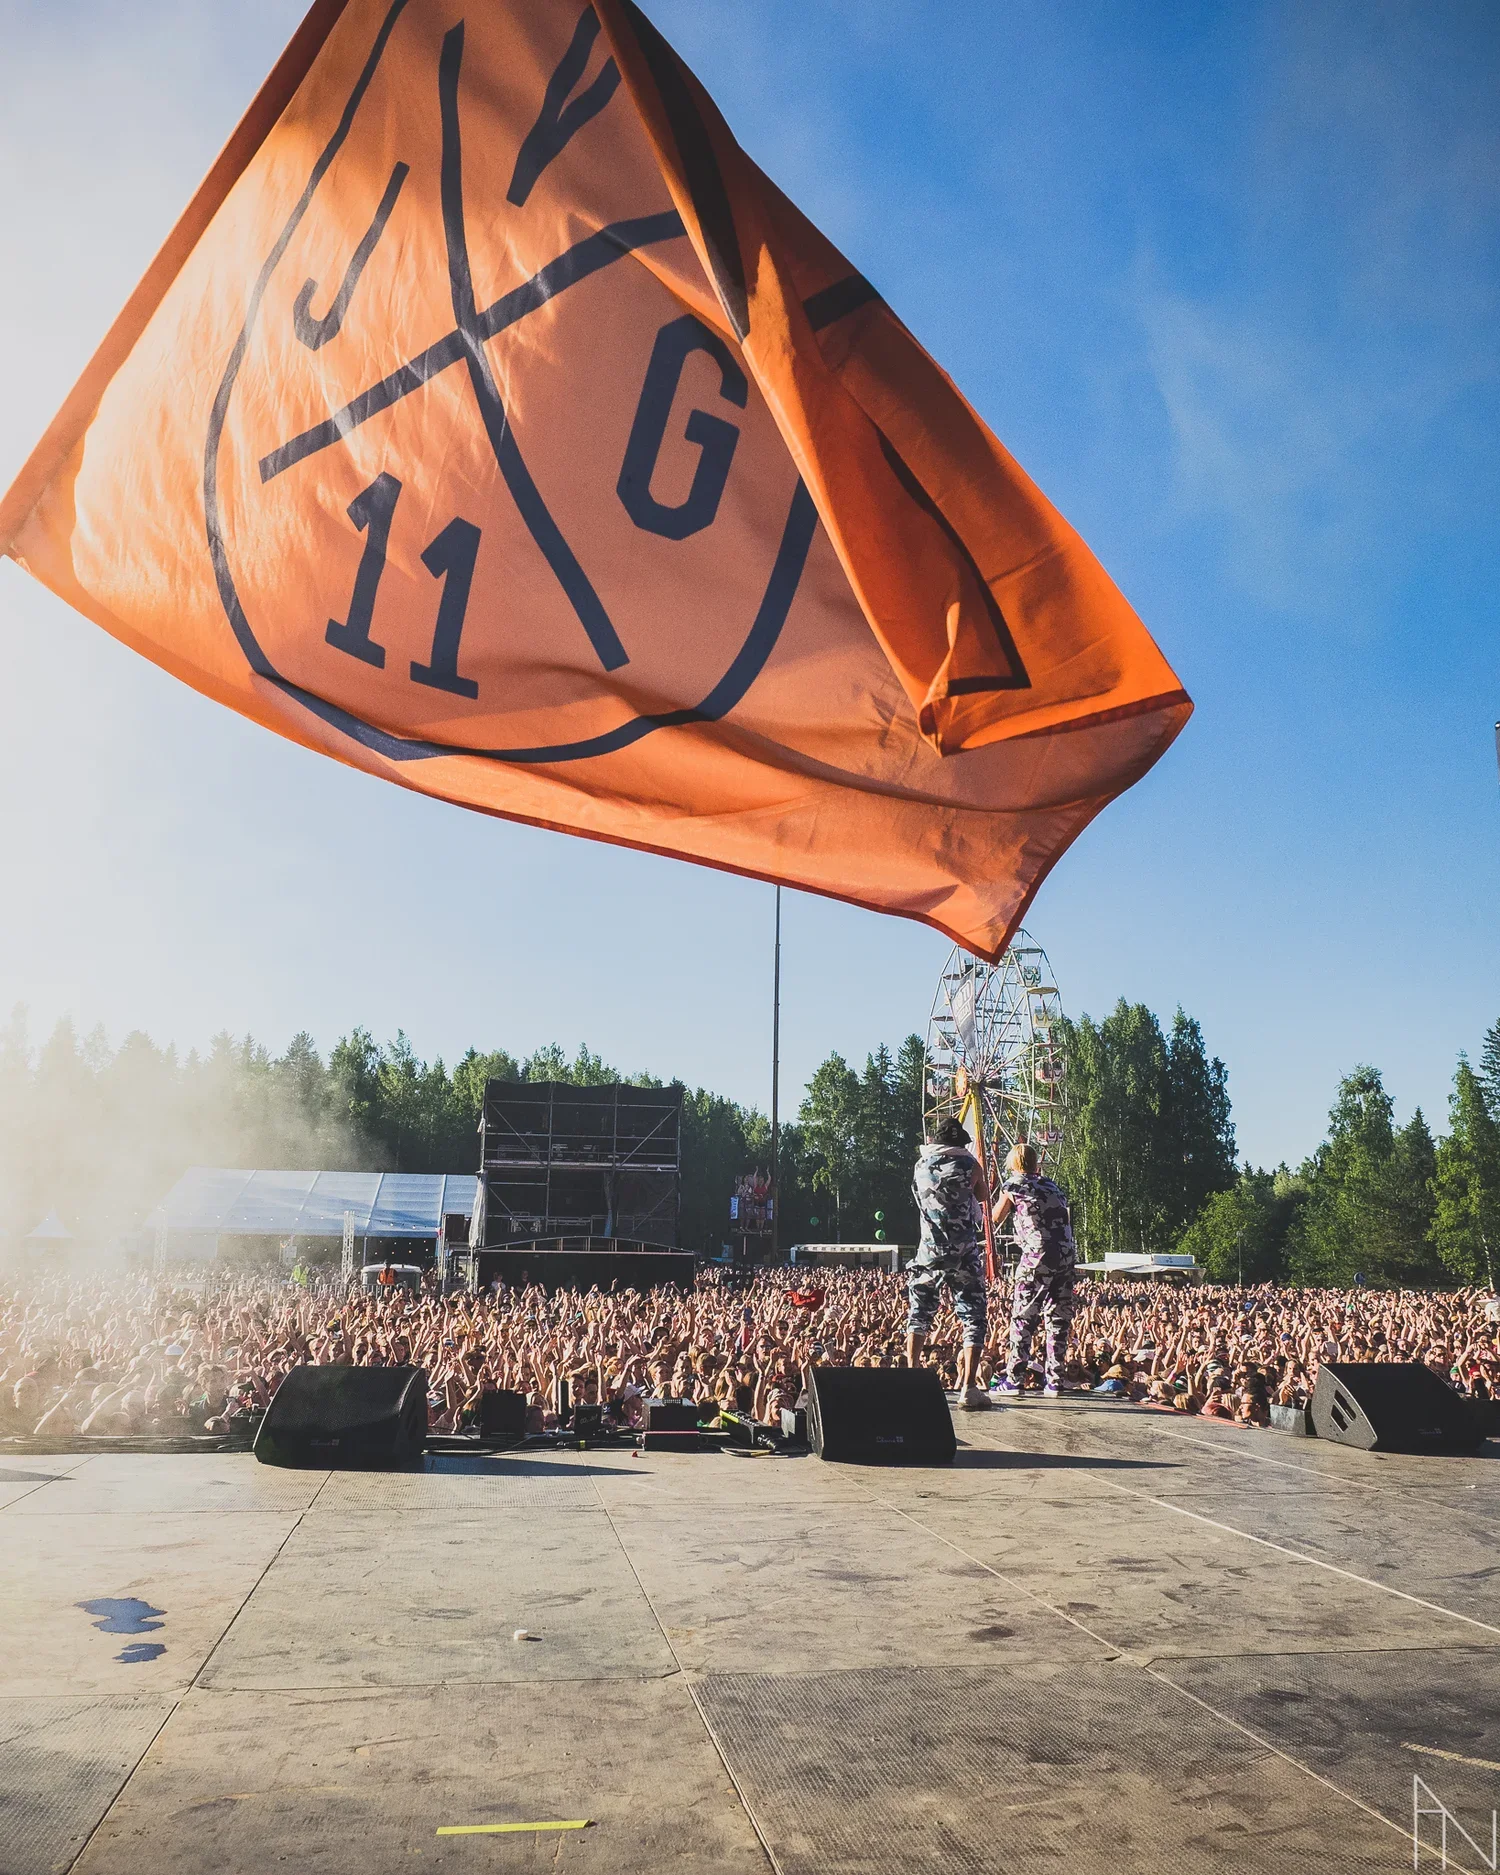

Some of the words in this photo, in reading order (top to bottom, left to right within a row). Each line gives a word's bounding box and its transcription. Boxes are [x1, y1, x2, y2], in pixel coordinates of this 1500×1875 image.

[293, 161, 410, 351] J
[616, 313, 749, 541] G
[325, 471, 481, 700] 11
